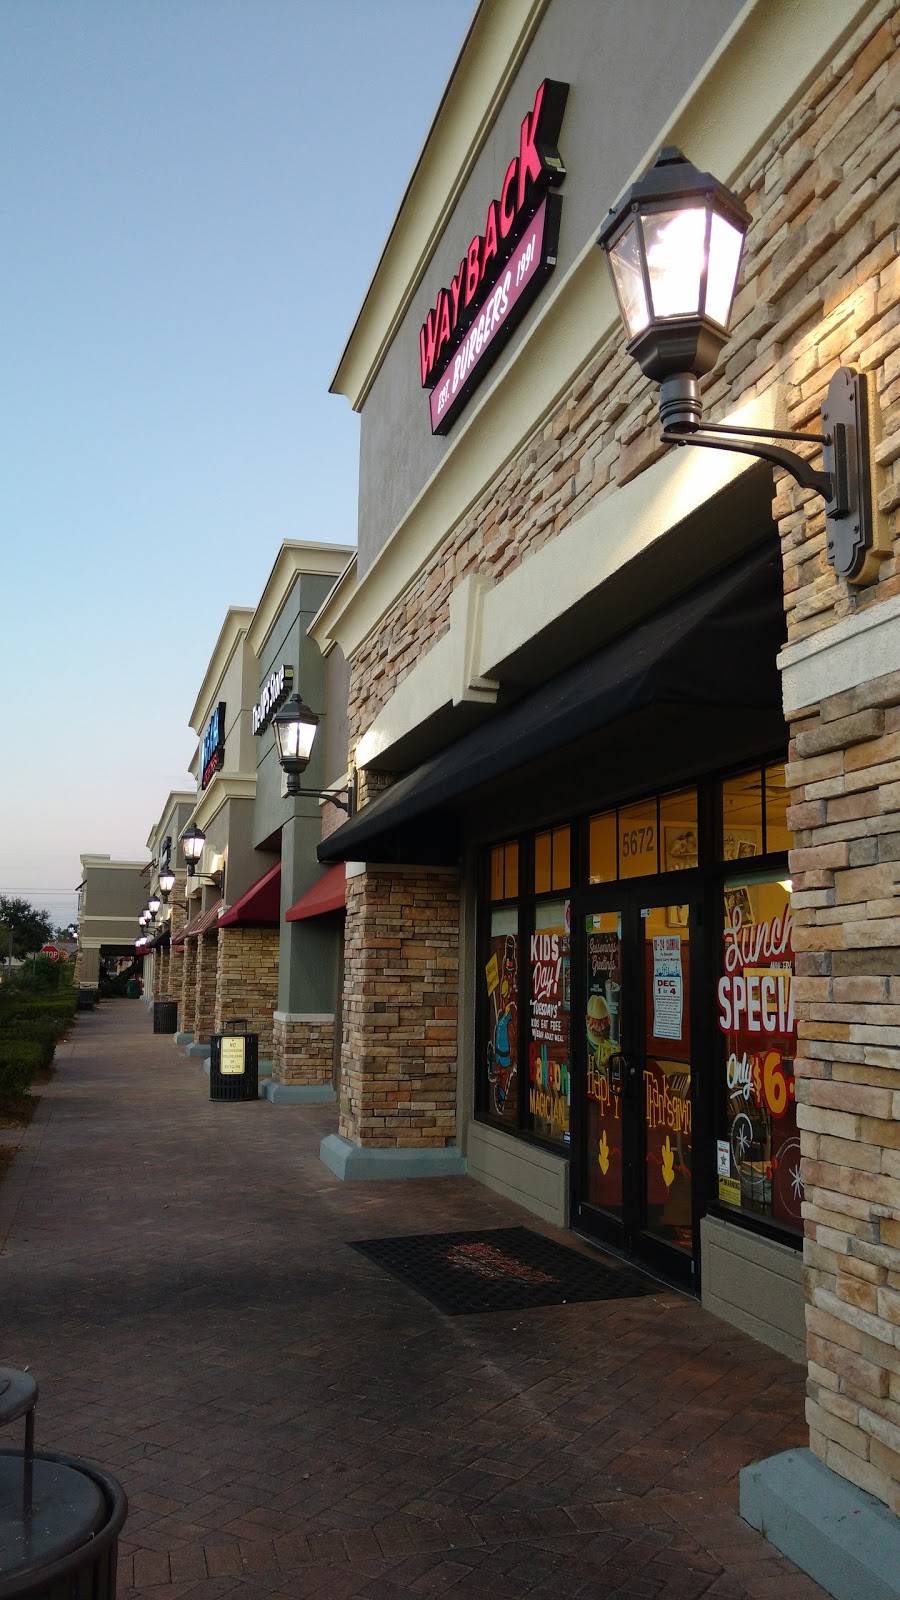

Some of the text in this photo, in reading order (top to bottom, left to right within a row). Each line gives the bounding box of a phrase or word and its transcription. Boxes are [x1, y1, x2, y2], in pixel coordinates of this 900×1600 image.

[419, 82, 546, 389] WAYBACK
[451, 270, 512, 394] BURGERS
[515, 233, 536, 287] 1991
[622, 826, 654, 858] 5672
[530, 933, 560, 962] KIDS
[723, 903, 793, 972] Lunch
[532, 956, 562, 999] Day!
[726, 1051, 754, 1101] Only
